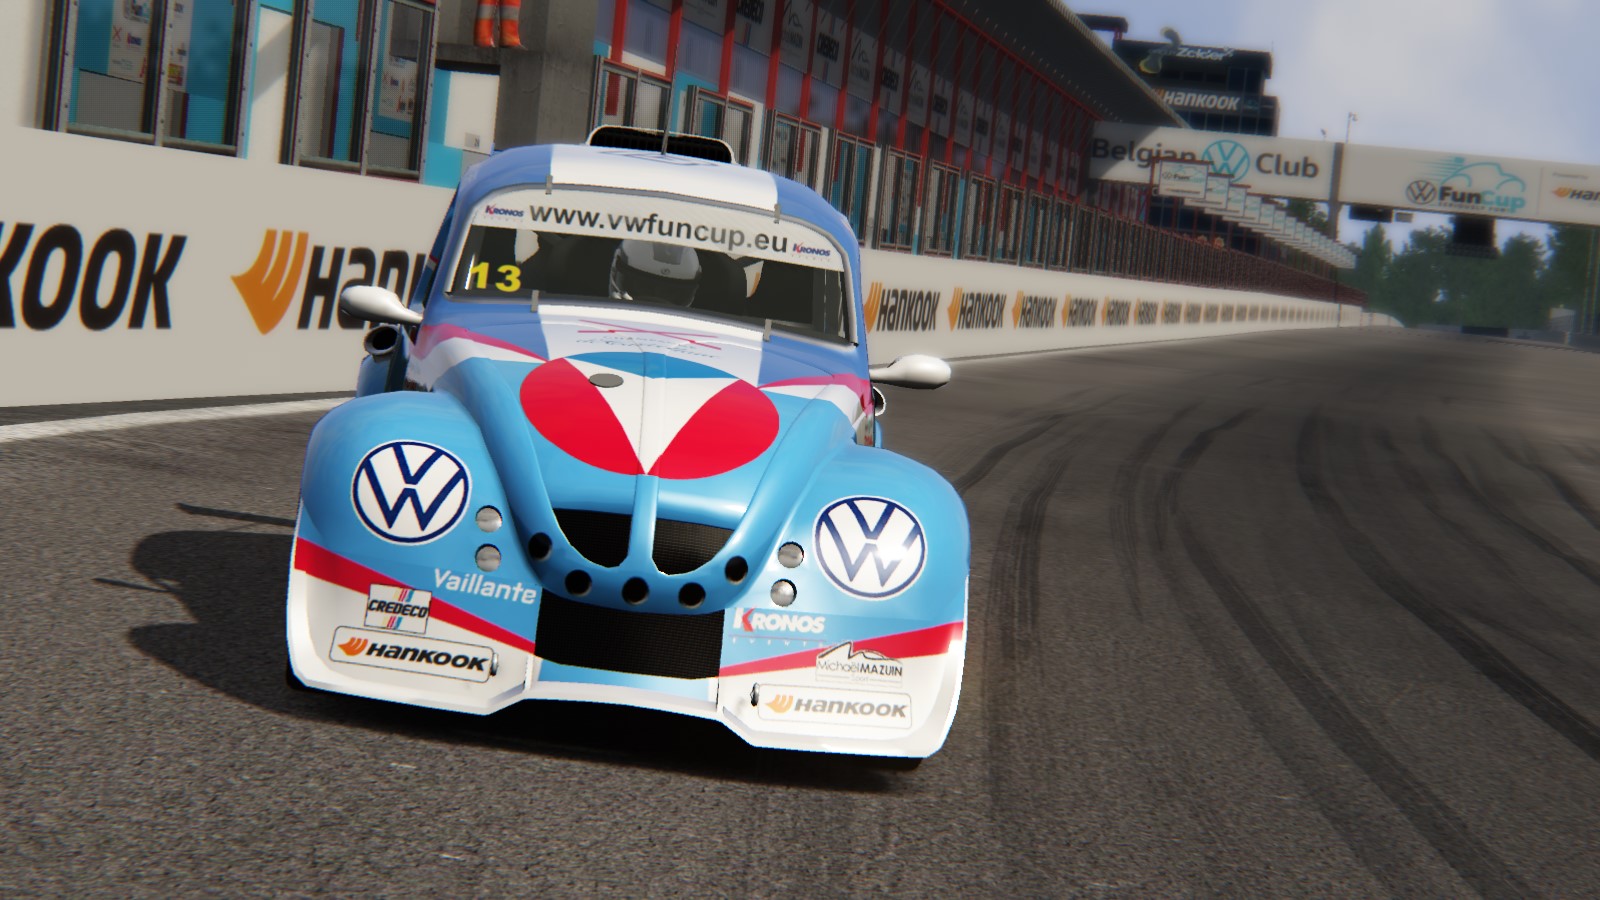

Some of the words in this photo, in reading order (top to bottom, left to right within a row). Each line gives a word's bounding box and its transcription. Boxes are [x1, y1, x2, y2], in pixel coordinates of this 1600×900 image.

[1092, 137, 1197, 169] Belgian
[1256, 152, 1319, 178] Club
[485, 204, 525, 218] KRONOS
[529, 204, 788, 253] www.vwfuncup.eu
[793, 241, 831, 257] KRONOS
[471, 261, 522, 293] 13
[434, 568, 537, 605] Vaillante
[367, 599, 430, 619] CREDECO
[733, 607, 826, 633] KRONOS
